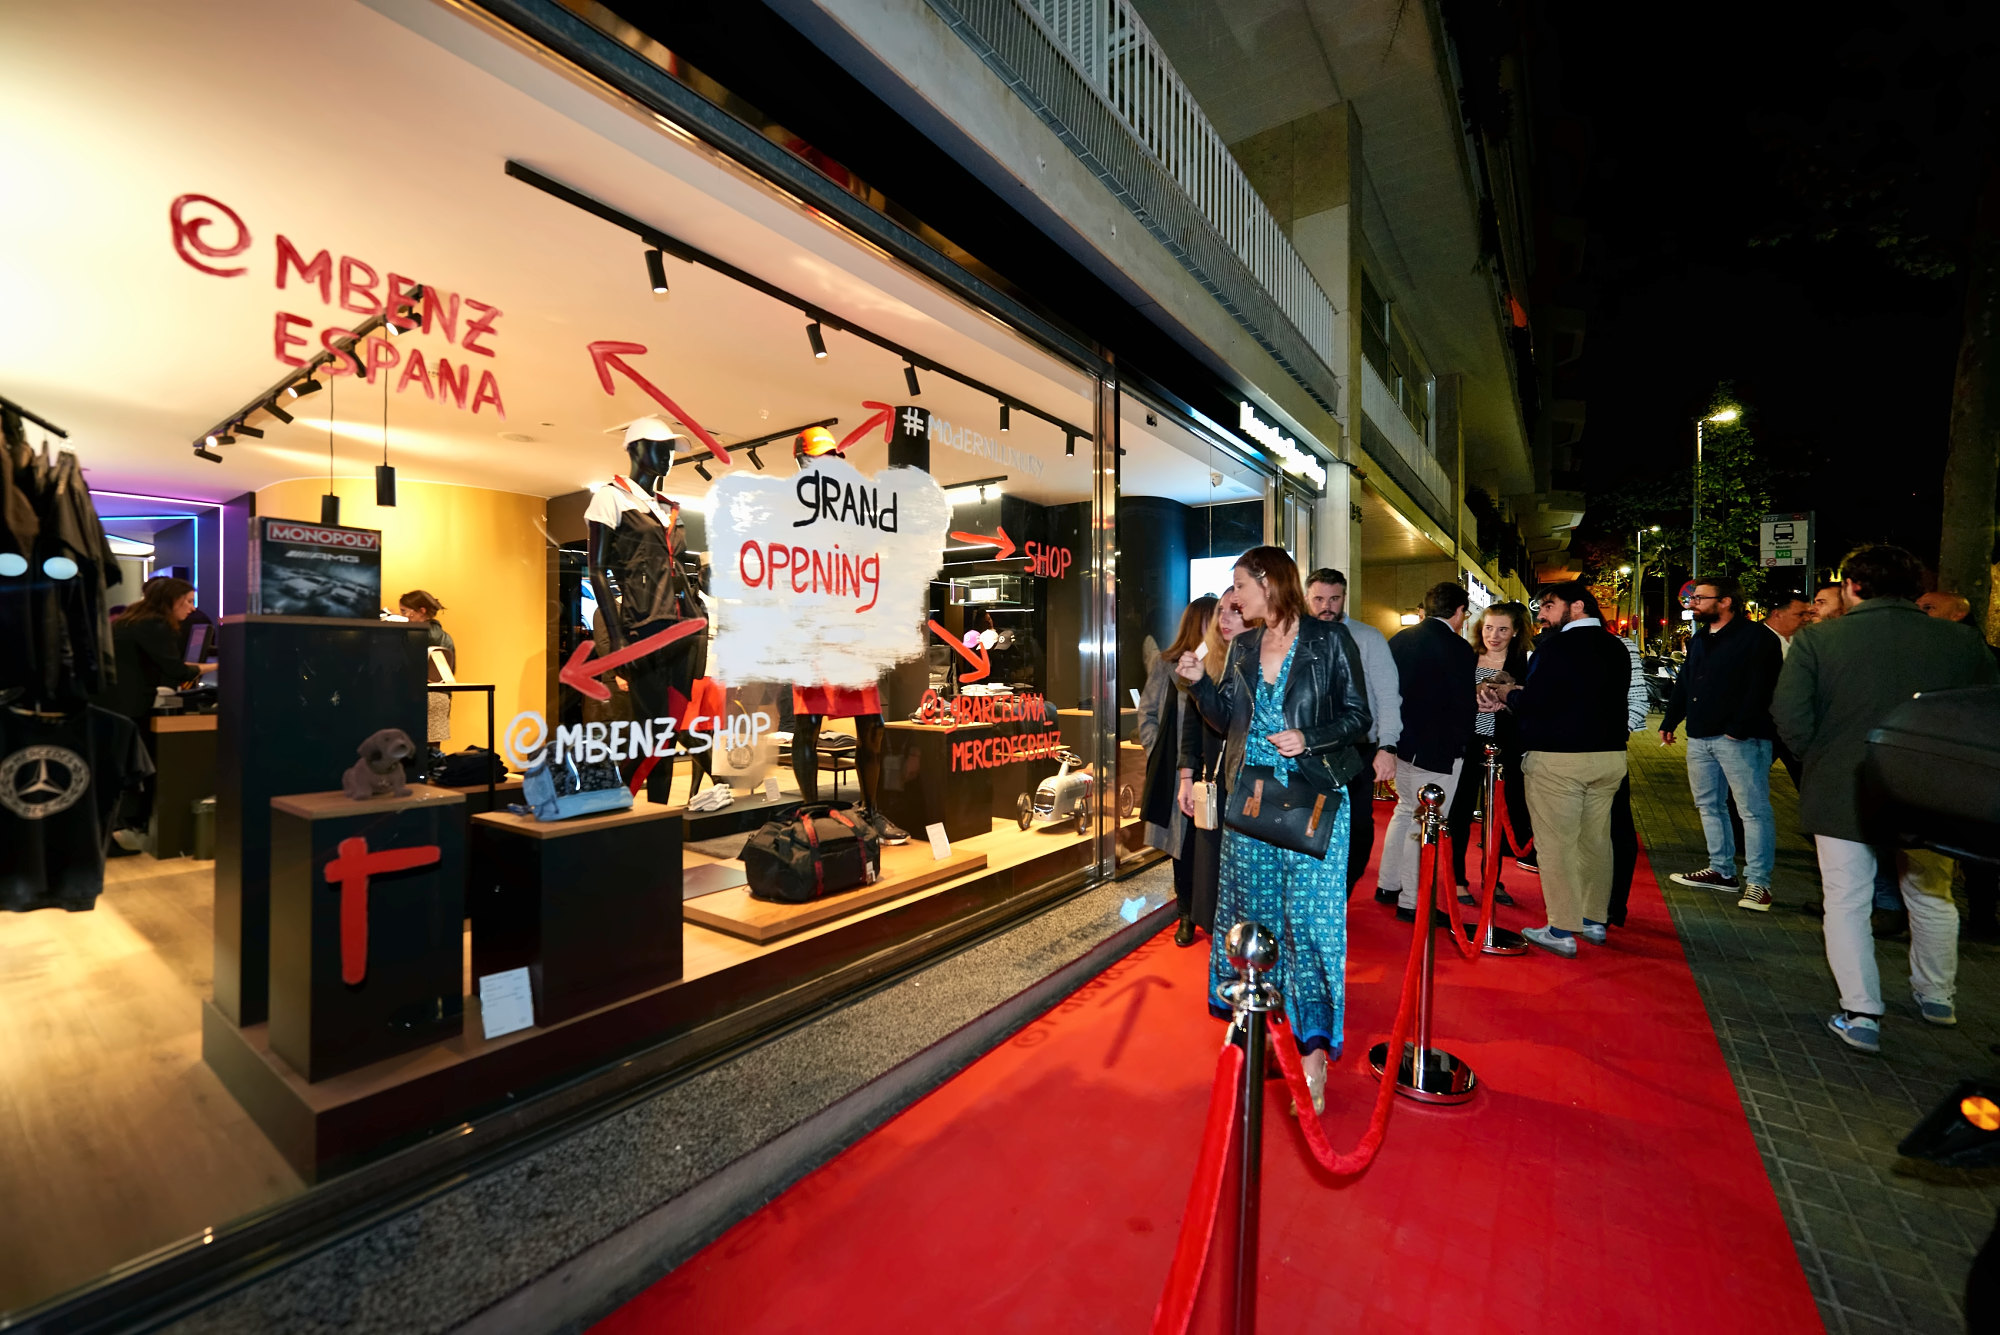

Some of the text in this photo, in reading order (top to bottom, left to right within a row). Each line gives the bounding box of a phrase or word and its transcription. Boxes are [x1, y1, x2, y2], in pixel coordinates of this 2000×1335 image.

[273, 311, 507, 420] ESPANA
[271, 526, 376, 549] MONOPOLY
[1023, 540, 1073, 580] SHOP
[504, 711, 771, 769] @MBENZ.SHOP
[951, 730, 1062, 773] MERCEDESBENZ
